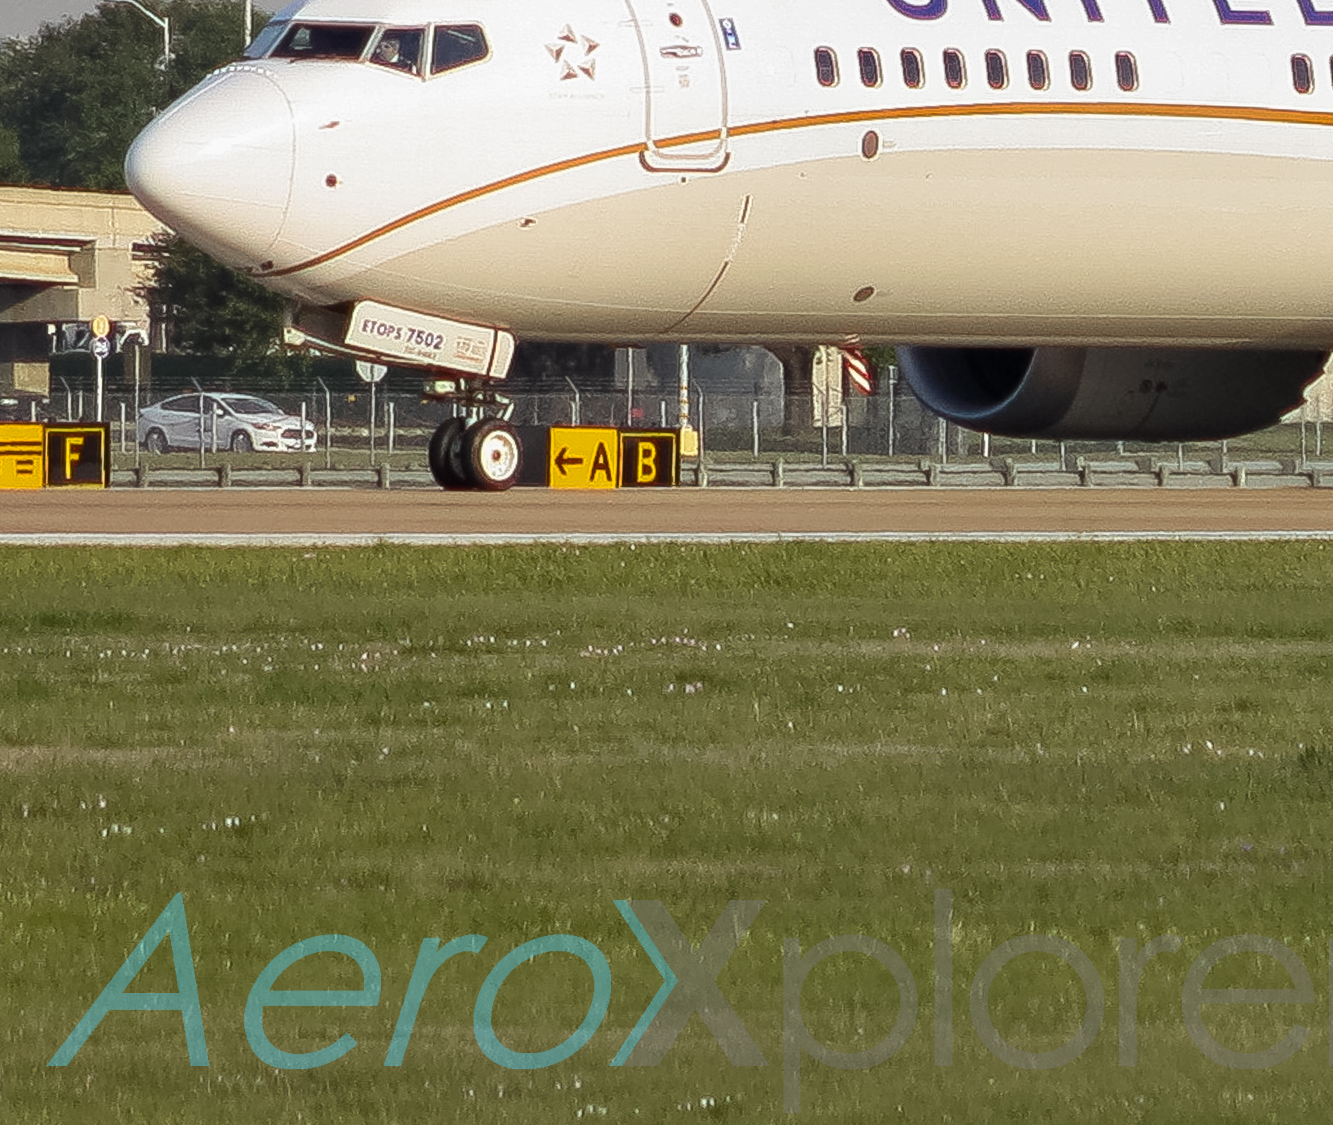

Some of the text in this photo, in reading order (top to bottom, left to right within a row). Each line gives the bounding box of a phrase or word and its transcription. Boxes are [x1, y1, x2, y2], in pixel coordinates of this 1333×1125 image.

[361, 319, 402, 340] ETOPS
[406, 328, 444, 350] 7502
[65, 436, 84, 480] F
[589, 441, 657, 484] A B
